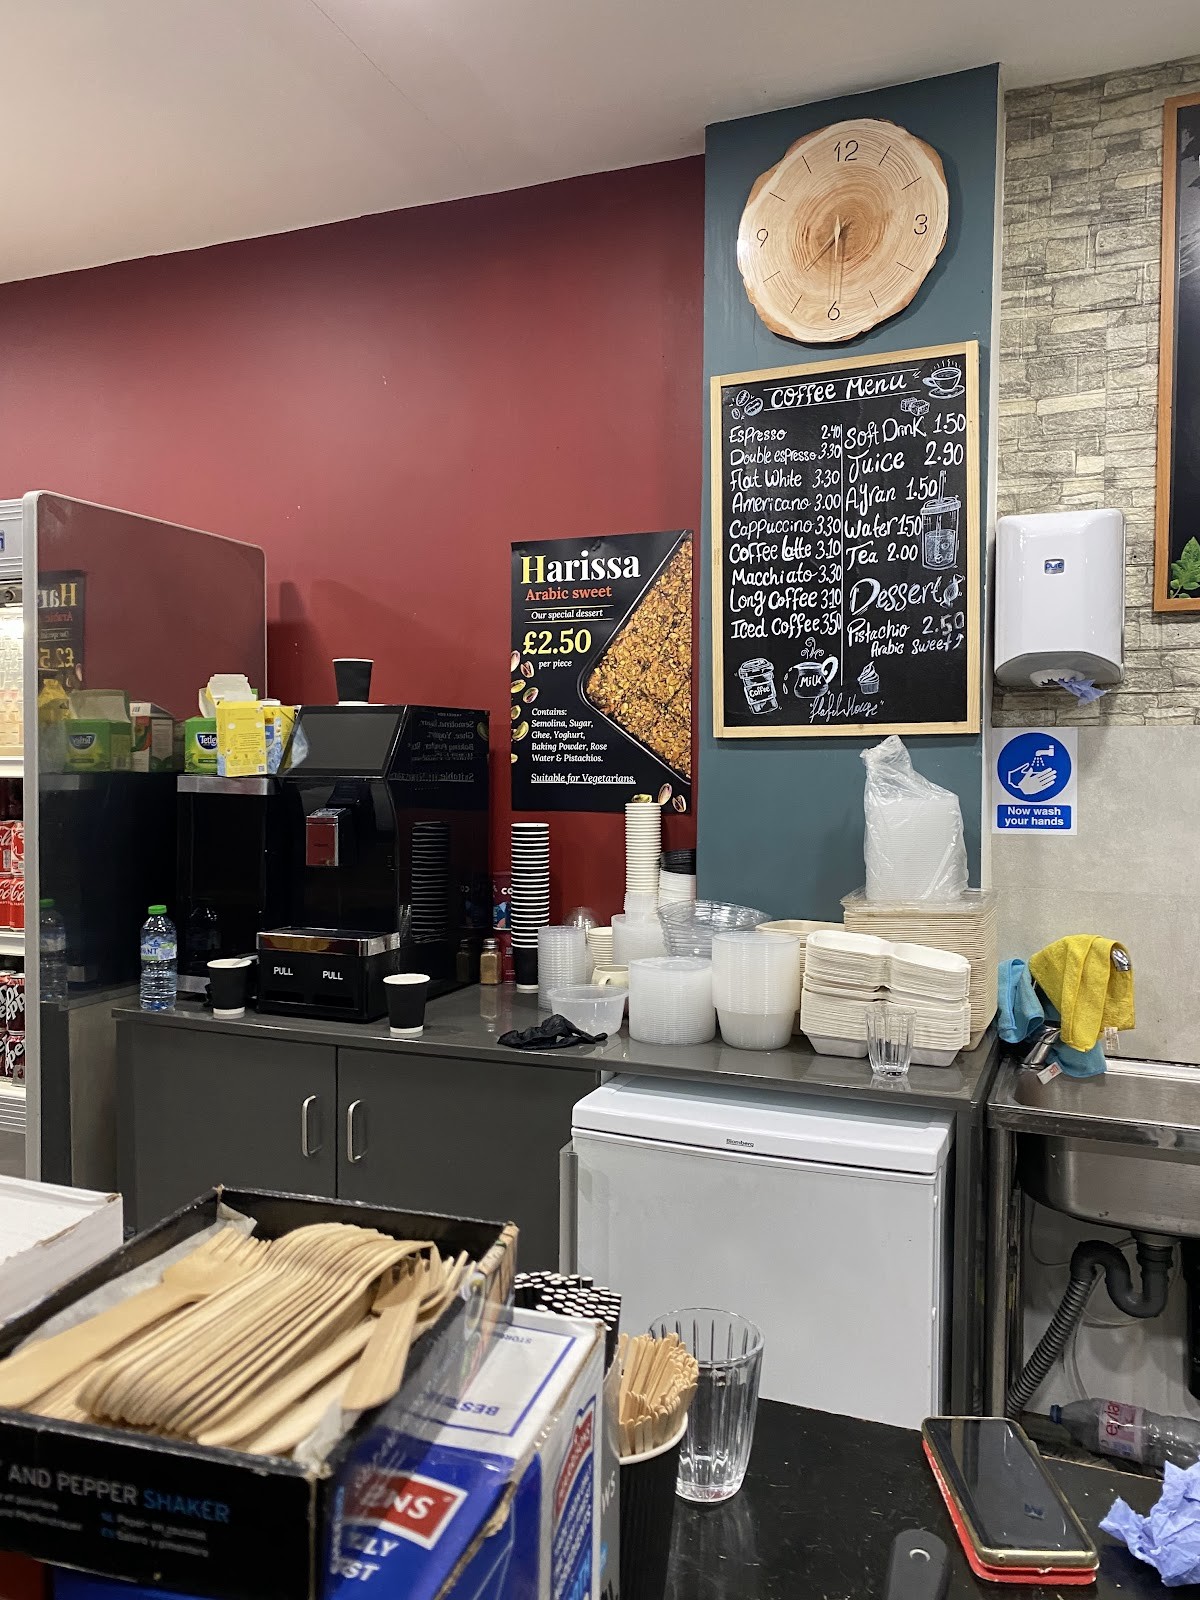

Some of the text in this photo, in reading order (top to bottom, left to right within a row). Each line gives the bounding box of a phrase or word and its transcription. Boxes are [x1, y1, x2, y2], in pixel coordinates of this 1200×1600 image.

[834, 140, 859, 162] 12
[914, 214, 928, 235] 3
[756, 228, 769, 248] 9
[827, 301, 840, 320] 6
[846, 374, 908, 399] Menu
[729, 424, 840, 446] Espresso 2.40
[844, 421, 880, 449] Soft
[933, 413, 966, 435] 1.50
[730, 442, 841, 466] Double espresso 3.30
[847, 440, 964, 483] Juice 2.90
[730, 468, 840, 492] Flat White 3.30
[732, 492, 841, 514] Americano 3.00
[846, 476, 938, 516] Ayran 1.50
[729, 515, 841, 540] Cappuccino 3.30
[844, 513, 922, 538] Water 1.50
[729, 535, 841, 565] Coffee Latte 3.10
[846, 541, 918, 571] Tea 2.00
[520, 550, 641, 584] Harissa
[818, 563, 842, 584] 3.30
[525, 586, 612, 601] Arabic sweet
[730, 587, 841, 617] Long Coffee 3.10
[849, 576, 942, 615] Dessert
[531, 609, 603, 621] Our special dessert
[731, 610, 841, 639] Iced Coffee 3.50
[847, 611, 964, 647] Pistachio 2.50
[522, 628, 592, 655] £2.50
[538, 659, 572, 670] per piece
[749, 686, 771, 698] Coffee
[531, 708, 567, 716] Contains:
[531, 719, 594, 729] Semolina, Sugar,
[531, 731, 585, 741] Ghee, Yoghurt,
[531, 743, 557, 752] Baking
[558, 743, 588, 752] Powder,
[532, 753, 603, 762] Water & Pistachios.
[531, 773, 636, 784] Suitable for Vegetarians.
[1004, 816, 1064, 827] your hands
[1007, 806, 1061, 816] Now wash
[273, 966, 293, 976] PULL
[322, 971, 343, 980] PULL
[8, 1464, 52, 1489] AND
[56, 1471, 139, 1506] PEPPER
[143, 1488, 232, 1524] SHAKER
